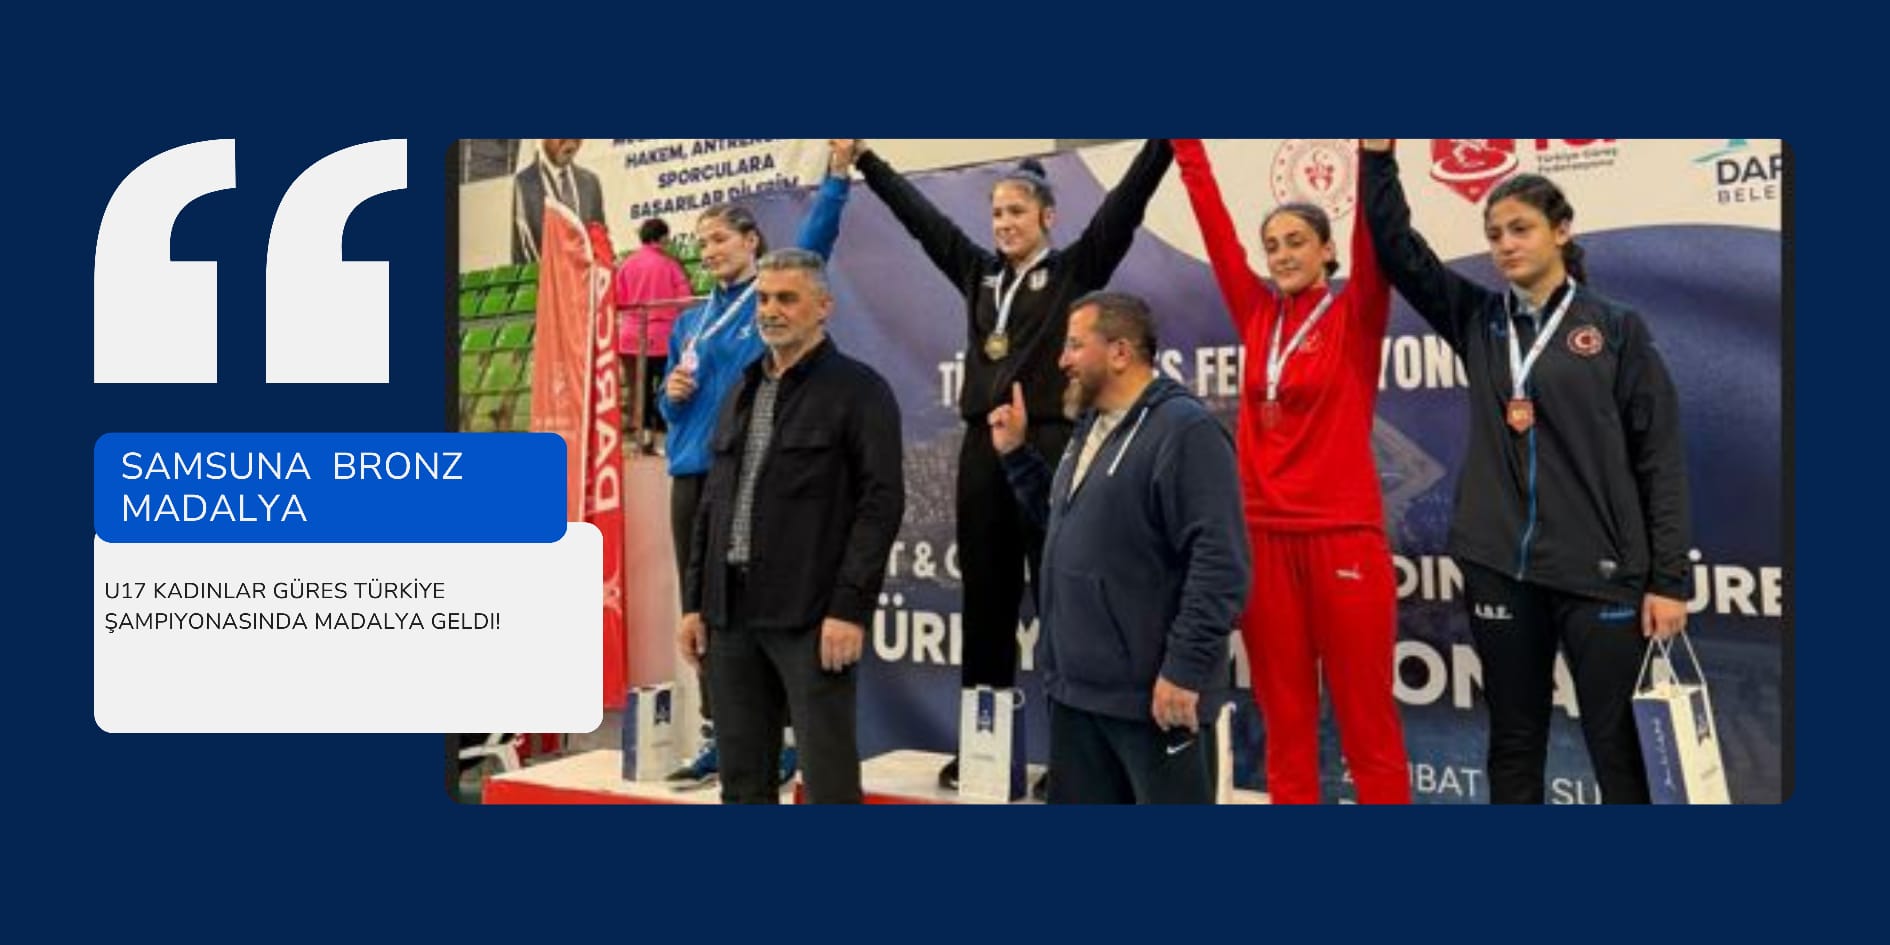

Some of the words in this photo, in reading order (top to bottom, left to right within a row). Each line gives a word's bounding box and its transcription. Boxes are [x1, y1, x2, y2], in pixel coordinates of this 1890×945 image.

[624, 144, 688, 170] HAKEM,
[657, 152, 776, 188] SPORCULARA
[1406, 762, 1483, 797] BAT
